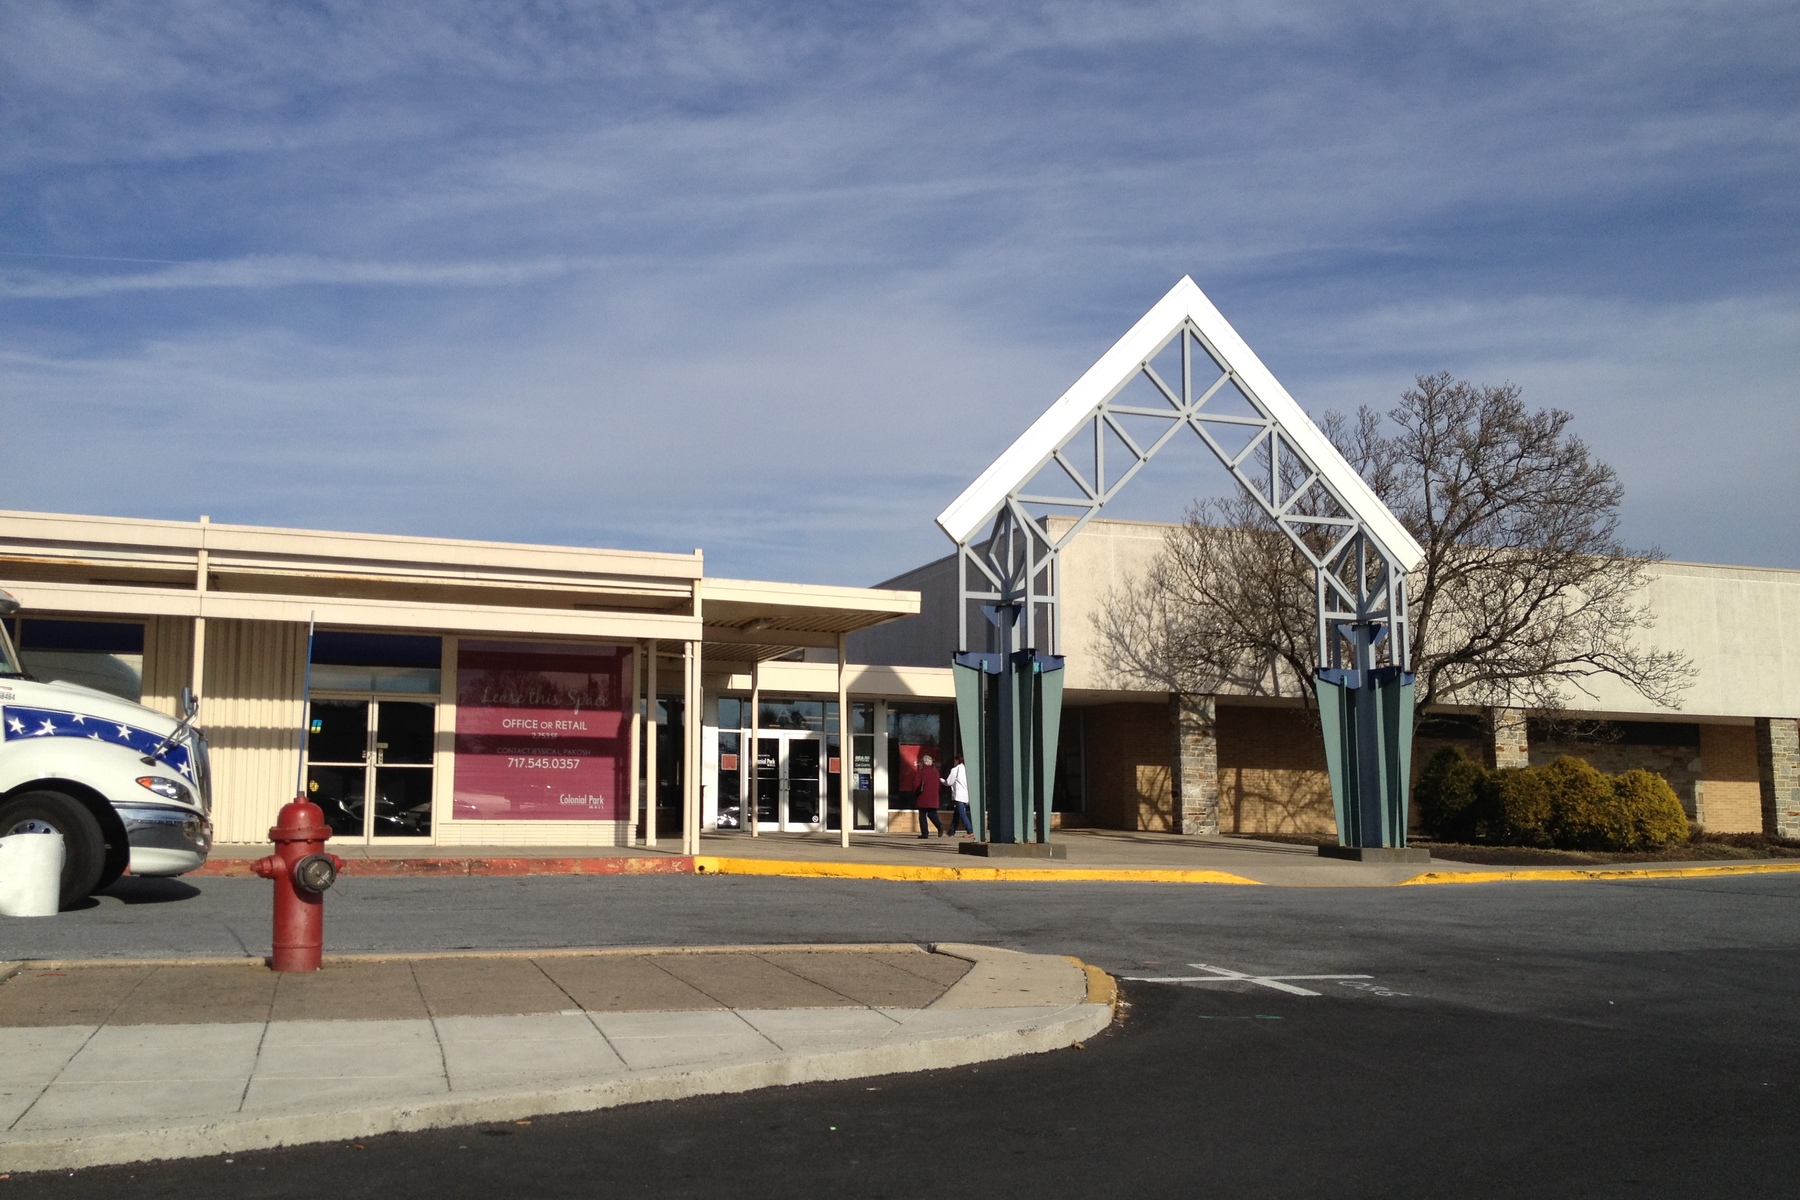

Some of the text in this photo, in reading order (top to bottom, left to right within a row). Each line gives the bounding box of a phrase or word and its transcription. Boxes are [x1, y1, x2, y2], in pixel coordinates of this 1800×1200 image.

[0, 691, 16, 701] 8464
[482, 685, 611, 715] Lease this Space
[502, 719, 587, 731] OFFICE OR RETAIL
[508, 757, 580, 769] 717.545.0357
[559, 793, 605, 805] Colonial Park
